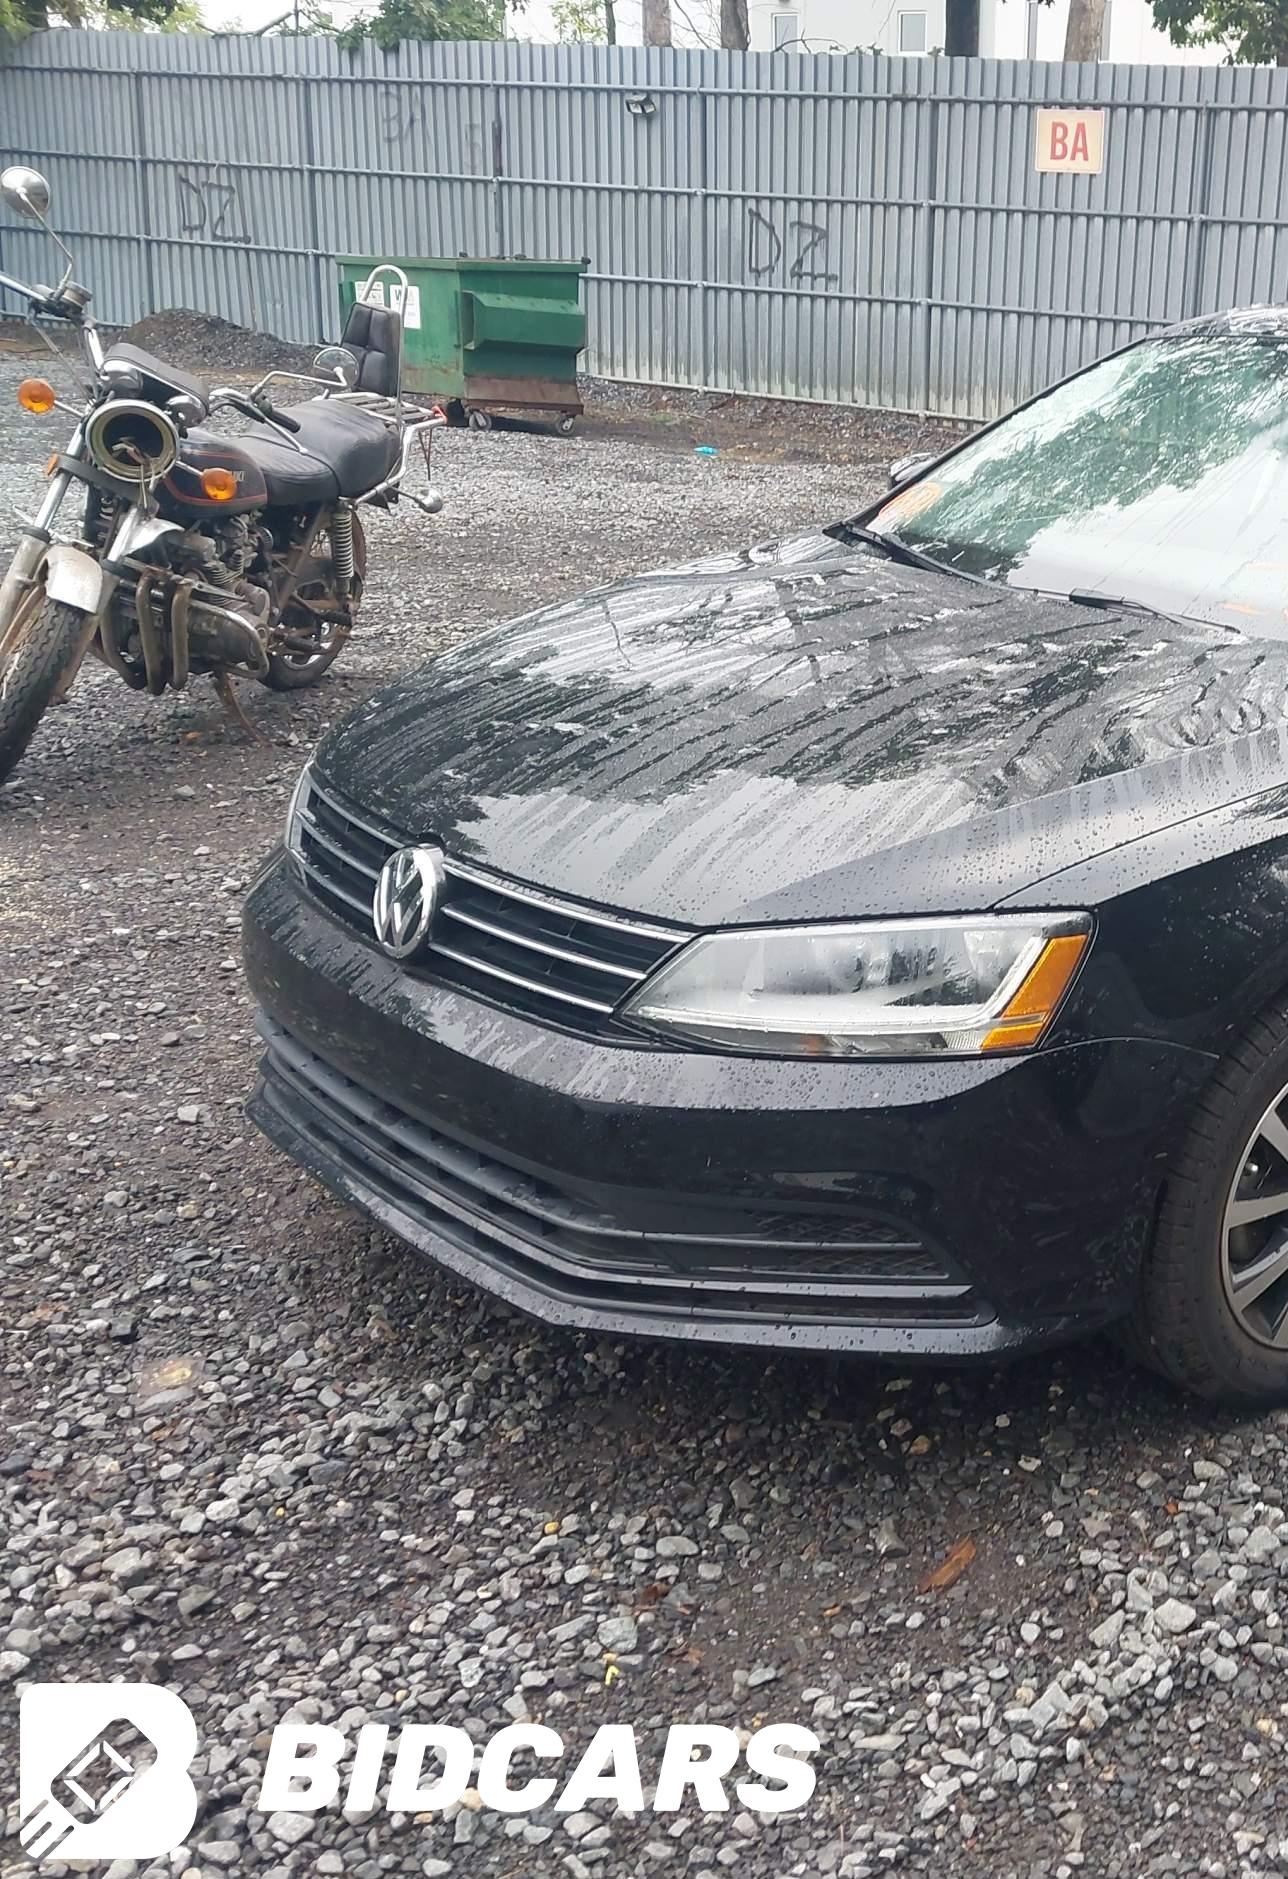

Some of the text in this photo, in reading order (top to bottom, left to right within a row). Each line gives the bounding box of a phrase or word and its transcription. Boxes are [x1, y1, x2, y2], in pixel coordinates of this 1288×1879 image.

[1050, 121, 1089, 162] BA
[179, 175, 251, 244] DZ
[748, 207, 839, 281] DZ
